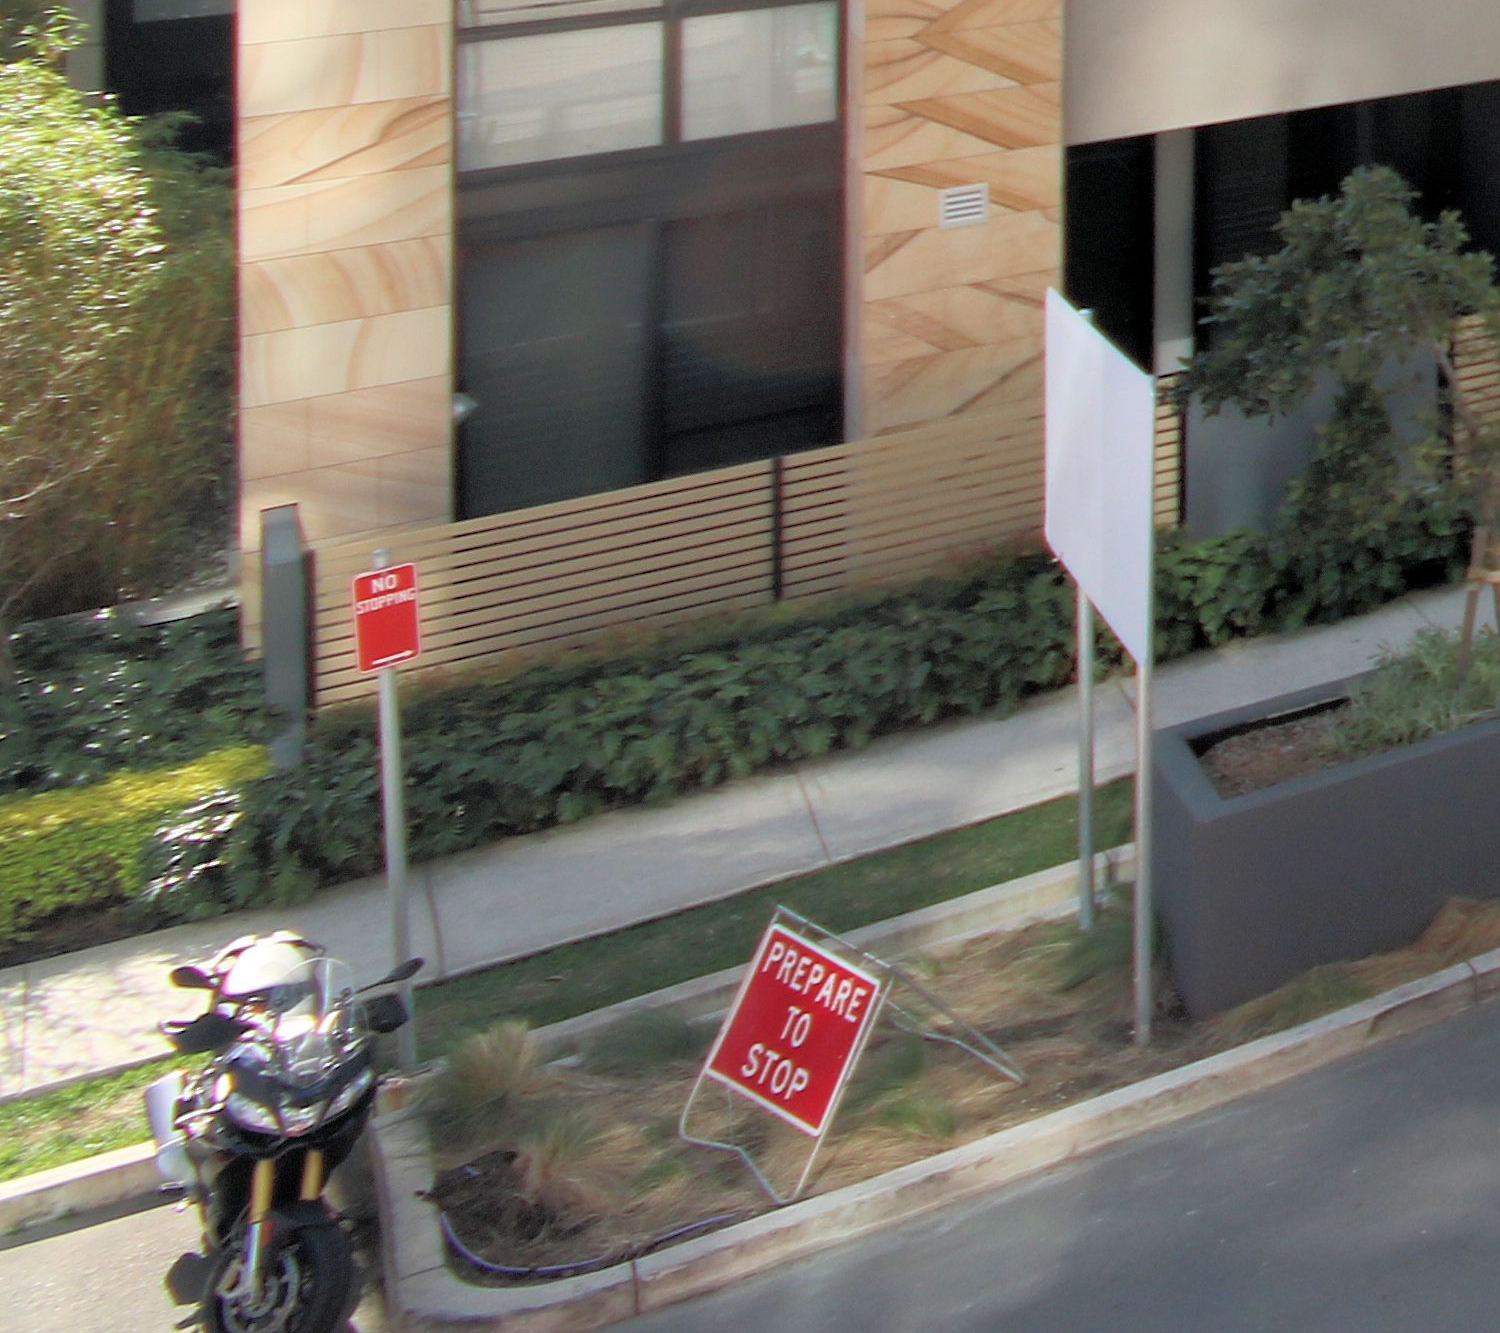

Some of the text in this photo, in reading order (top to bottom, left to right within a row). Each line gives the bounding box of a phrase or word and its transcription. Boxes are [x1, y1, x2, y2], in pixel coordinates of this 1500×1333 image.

[357, 587, 417, 614] STOPPING
[371, 574, 397, 594] NO
[762, 941, 868, 1023] PREPARE
[780, 1005, 813, 1048] TO
[741, 1043, 810, 1100] STOP
